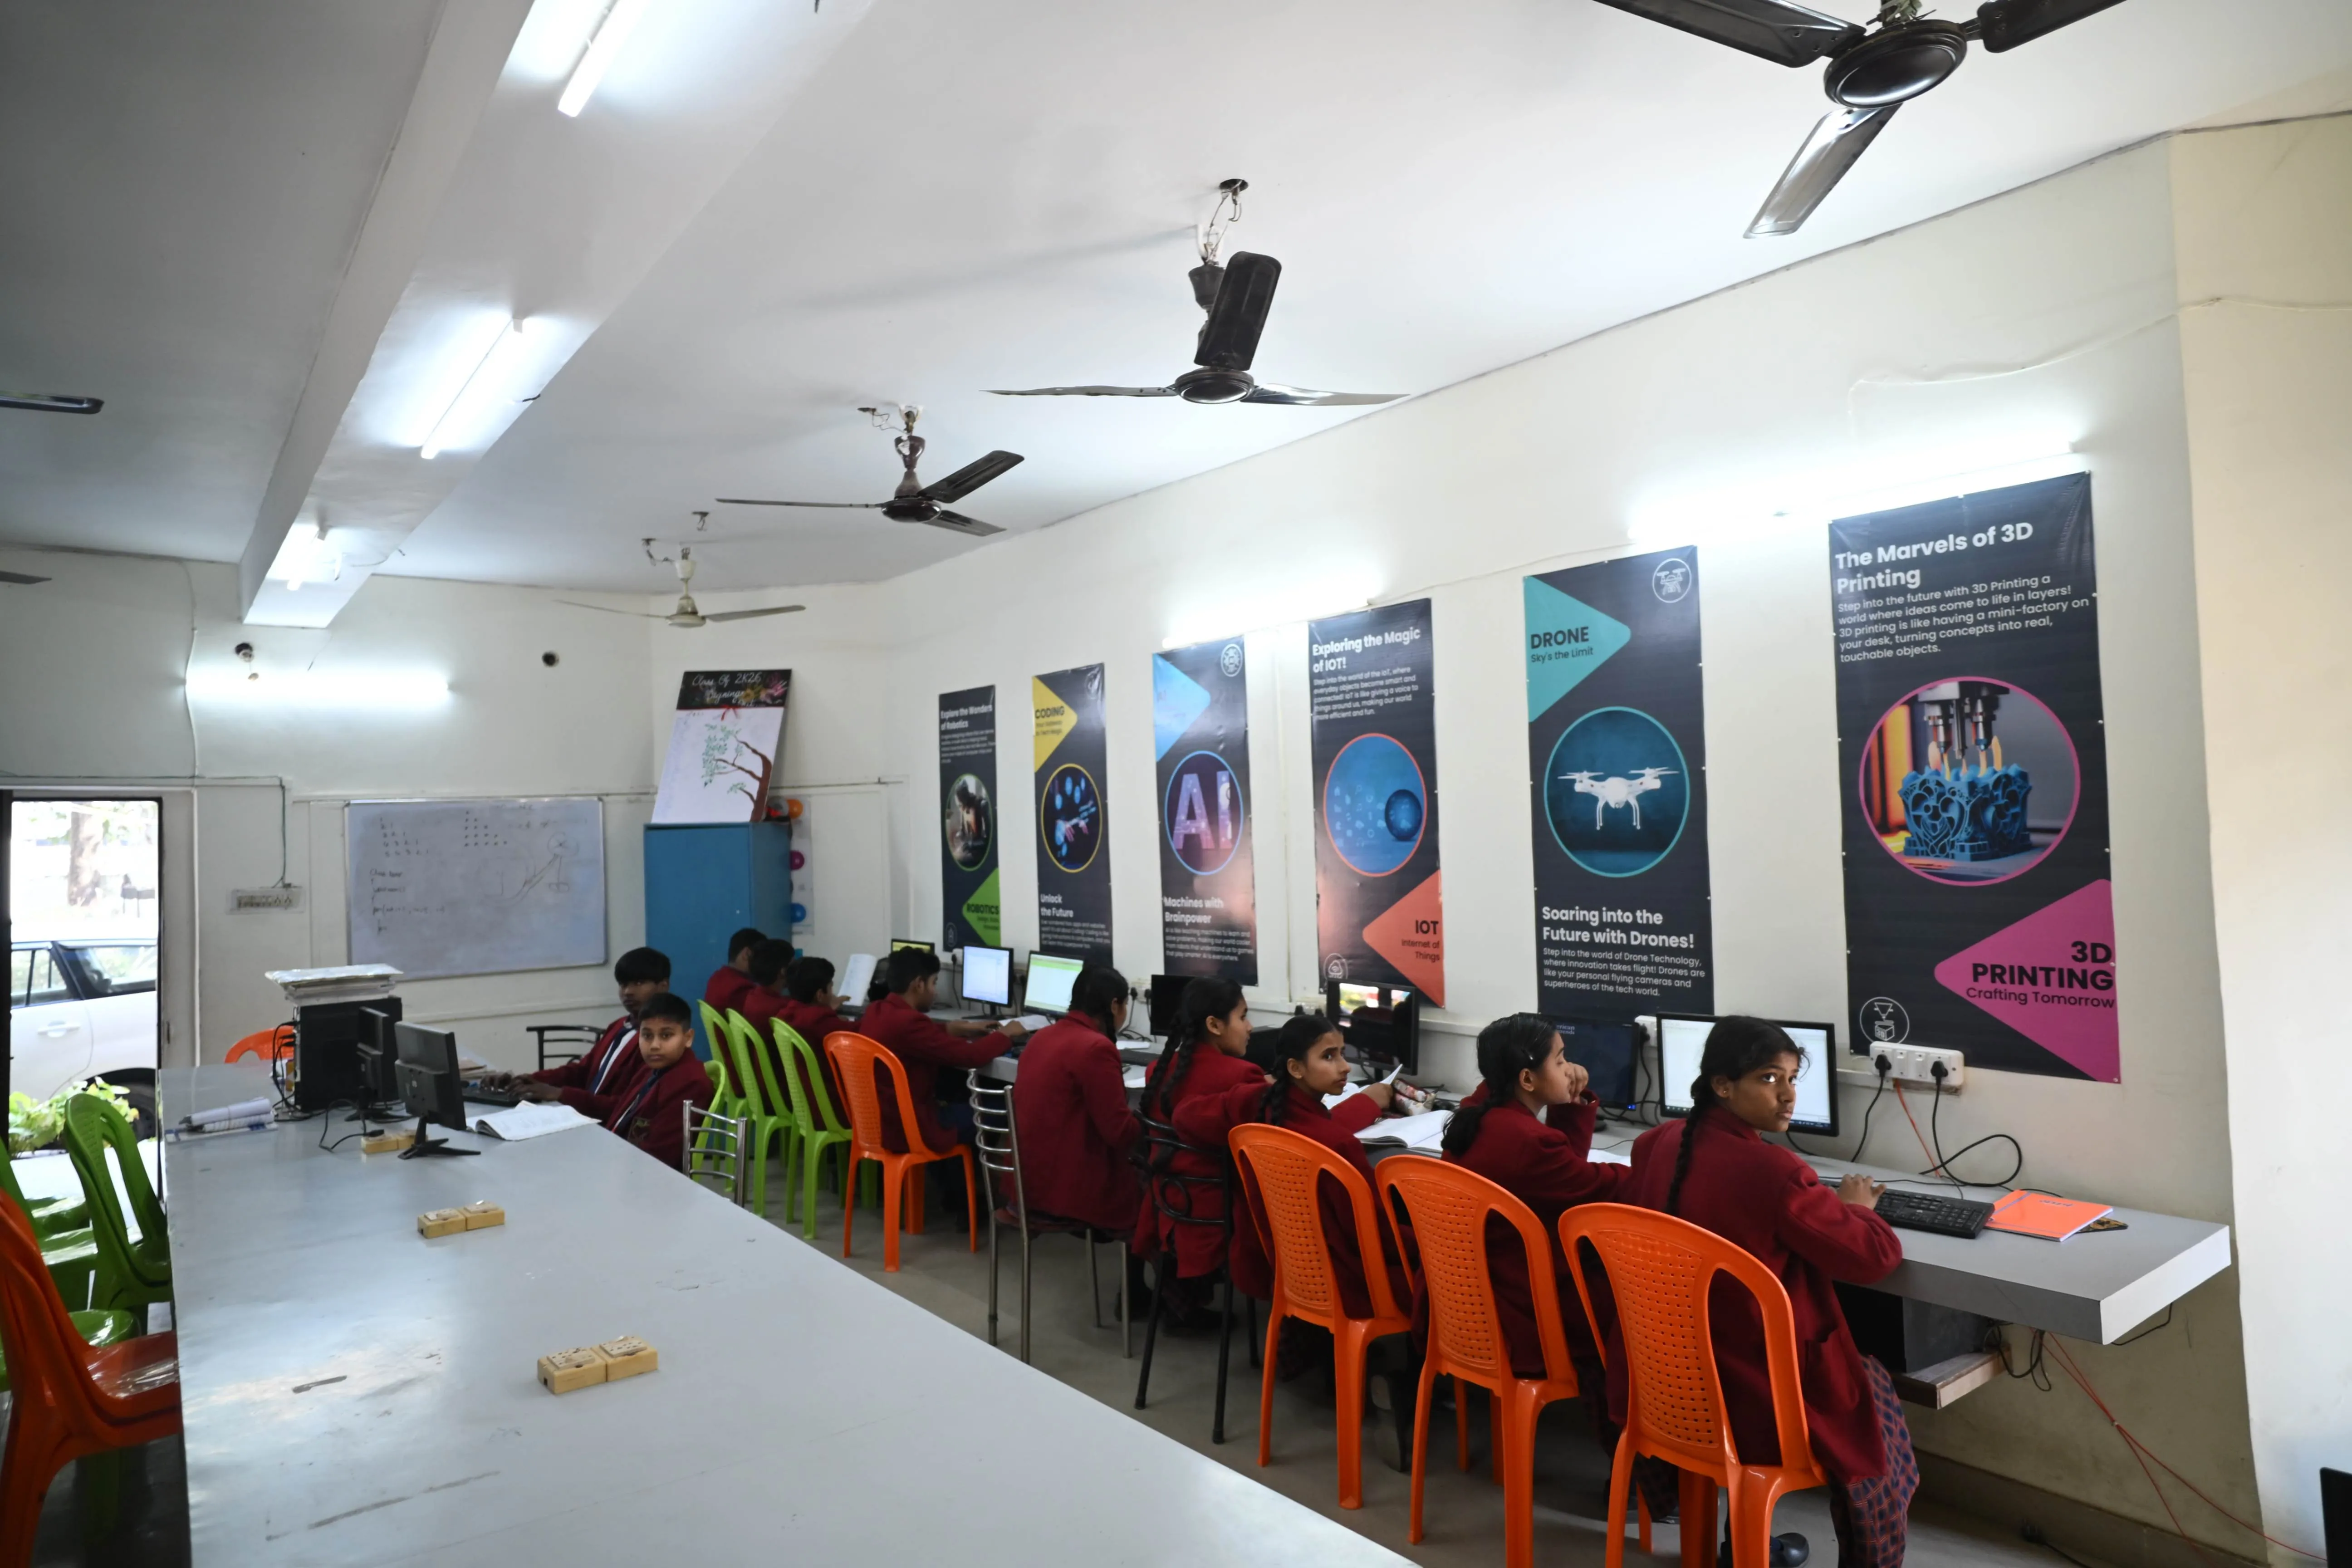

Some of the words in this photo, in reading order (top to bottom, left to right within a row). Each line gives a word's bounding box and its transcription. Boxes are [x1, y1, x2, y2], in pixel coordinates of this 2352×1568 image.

[1836, 550, 1872, 570] The
[1877, 535, 1967, 564] Marvels
[1973, 528, 1995, 549] of
[2001, 522, 2033, 544] 3D
[1838, 568, 1921, 593] Printing
[1838, 602, 1861, 613] Step
[1863, 598, 1883, 608] into
[1886, 594, 1904, 605] the
[1907, 591, 1941, 603] future
[1944, 585, 1969, 598] with
[1972, 582, 1987, 593] 3D
[1991, 578, 2038, 591] Printing
[2042, 576, 2050, 584] a
[1839, 611, 1866, 624] world
[1869, 608, 1902, 620] where
[1906, 604, 1936, 615] ideas
[1940, 599, 1974, 611] come
[1977, 597, 1989, 606] to
[1992, 593, 2010, 604] life
[2014, 592, 2024, 601] in
[2028, 584, 2071, 601] layers!
[1840, 627, 1852, 637] 3D
[1855, 623, 1896, 639] printing
[1899, 621, 1907, 630] is
[1911, 617, 1930, 629] like
[1933, 614, 1974, 626] having
[1988, 602, 2067, 619] mini-factory
[2072, 600, 2088, 608] on
[1313, 638, 1362, 658] Exploring
[1364, 635, 1382, 647] the
[1385, 627, 1421, 645] Magic
[1531, 627, 1589, 649] DRONE
[1840, 640, 1862, 652] your
[1865, 634, 1892, 647] desk,
[1895, 632, 1936, 643] turning
[1939, 624, 1994, 638] concepts
[1998, 621, 2021, 632] into
[2025, 617, 2053, 629] real,
[1531, 653, 1552, 664] Sky's
[1555, 651, 1569, 660] the
[1572, 647, 1593, 657] Limit
[1841, 648, 1893, 662] touchable
[1896, 644, 1940, 658] objects.
[1313, 659, 1324, 672] of
[1326, 657, 1346, 671] IOT!
[1035, 706, 1064, 719] CODING
[1040, 894, 1062, 904] Unlock
[1163, 897, 1203, 907] Machines
[1205, 897, 1224, 908] with
[967, 903, 999, 914] ROBOTICS
[1041, 907, 1051, 916] the
[1052, 907, 1073, 917] Future
[1543, 906, 1598, 926] Soaring
[1602, 907, 1633, 923] into
[1636, 909, 1663, 924] the
[1165, 911, 1211, 926] Brainpower
[1415, 920, 1439, 935] IOT
[1402, 939, 1430, 948] Internet
[1543, 927, 1590, 942] Future
[1593, 929, 1627, 944] with
[1631, 931, 1694, 948] Drones!
[1416, 951, 1440, 962] Things
[1544, 947, 1559, 958] Step
[1624, 953, 1648, 961] Drone
[1650, 955, 1702, 967] Technology,
[2071, 941, 2112, 964] 3D
[1544, 958, 1566, 966] where
[1568, 960, 1607, 970] innovation
[1610, 963, 1631, 971] takes
[1633, 965, 1656, 975] flight!
[1659, 967, 1688, 976] Drones
[1612, 974, 1633, 985] flying
[1973, 963, 2113, 991] PRINTING
[1544, 981, 1590, 990] superheroes
[1616, 985, 1633, 994] tech
[1966, 987, 2028, 1005] Crafting
[2033, 991, 2115, 1008] Tomorrow
